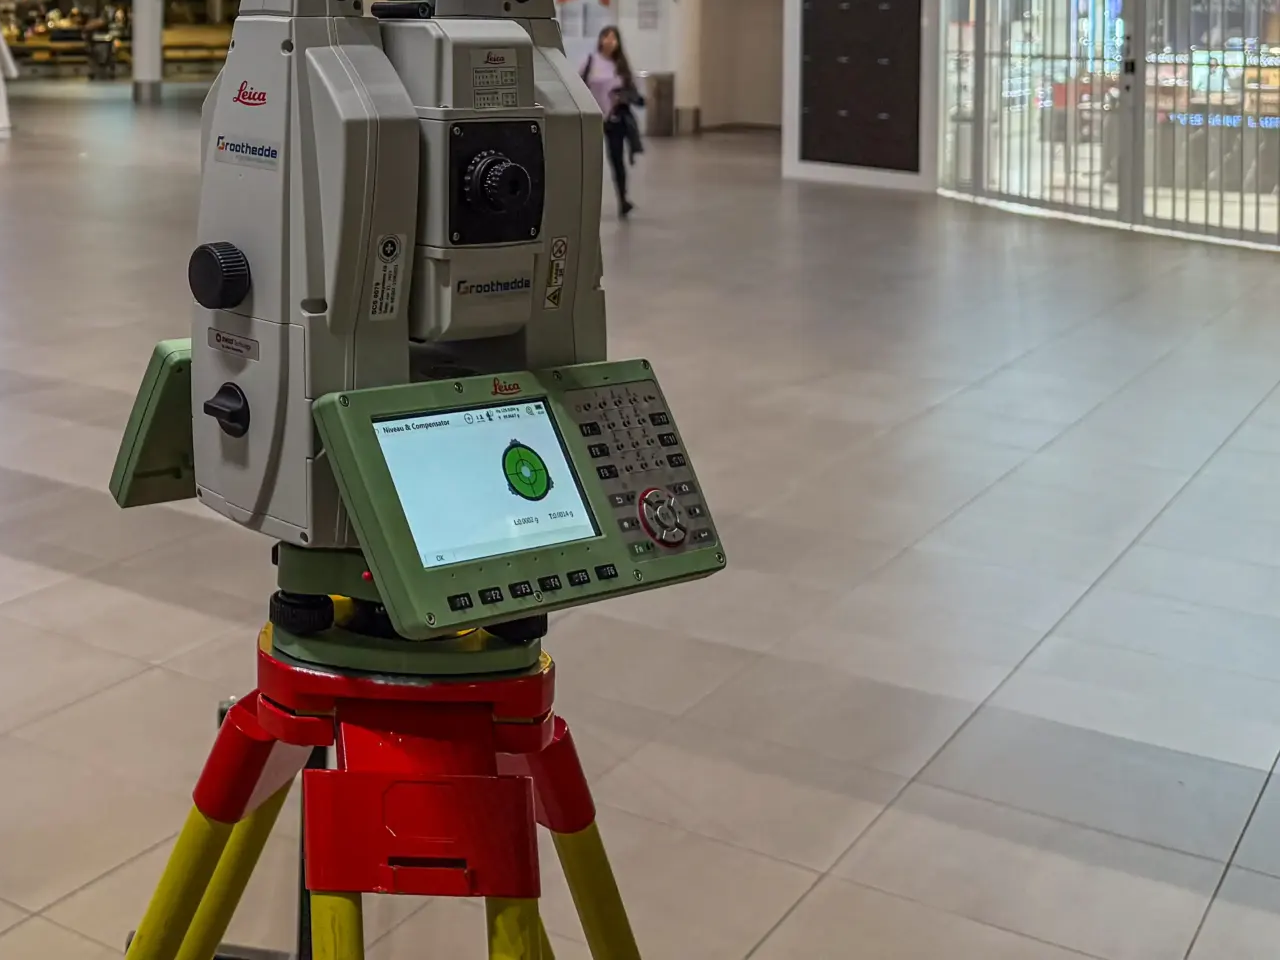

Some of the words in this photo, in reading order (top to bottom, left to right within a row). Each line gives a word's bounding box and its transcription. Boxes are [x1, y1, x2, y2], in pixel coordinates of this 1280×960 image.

[483, 51, 507, 64] Leica
[232, 80, 267, 106] Leica
[216, 135, 278, 159] Groothedde
[457, 277, 531, 296] Groothedde
[491, 377, 522, 396] Leica
[383, 423, 405, 434] Niveau
[404, 423, 412, 431] &
[411, 419, 450, 430] Compensator
[436, 554, 445, 562] OK
[606, 565, 615, 575] F6
[579, 572, 588, 581] F5
[550, 578, 560, 587] F4
[521, 584, 530, 594] F3
[491, 590, 500, 600] F2
[461, 597, 470, 606] F1
